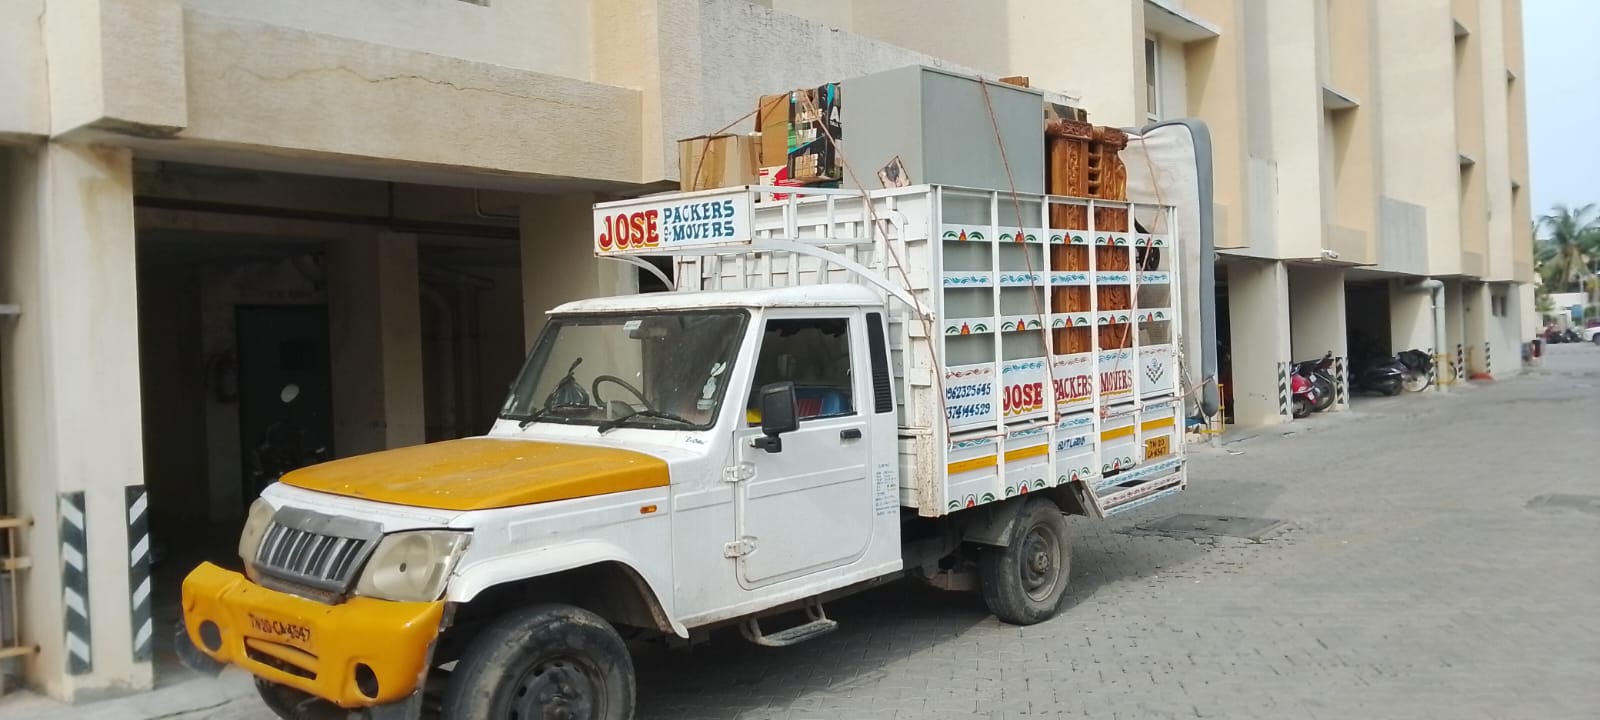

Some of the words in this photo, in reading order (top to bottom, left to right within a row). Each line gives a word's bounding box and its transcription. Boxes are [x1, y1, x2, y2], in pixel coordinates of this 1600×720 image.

[599, 209, 660, 250] JOSE
[663, 200, 735, 225] PACKERS
[672, 221, 735, 242] MOVERS
[1002, 382, 1044, 415] JOSE
[1053, 374, 1093, 401] PACKERS
[1100, 369, 1132, 393] MOVERS
[945, 403, 991, 420] 374144529
